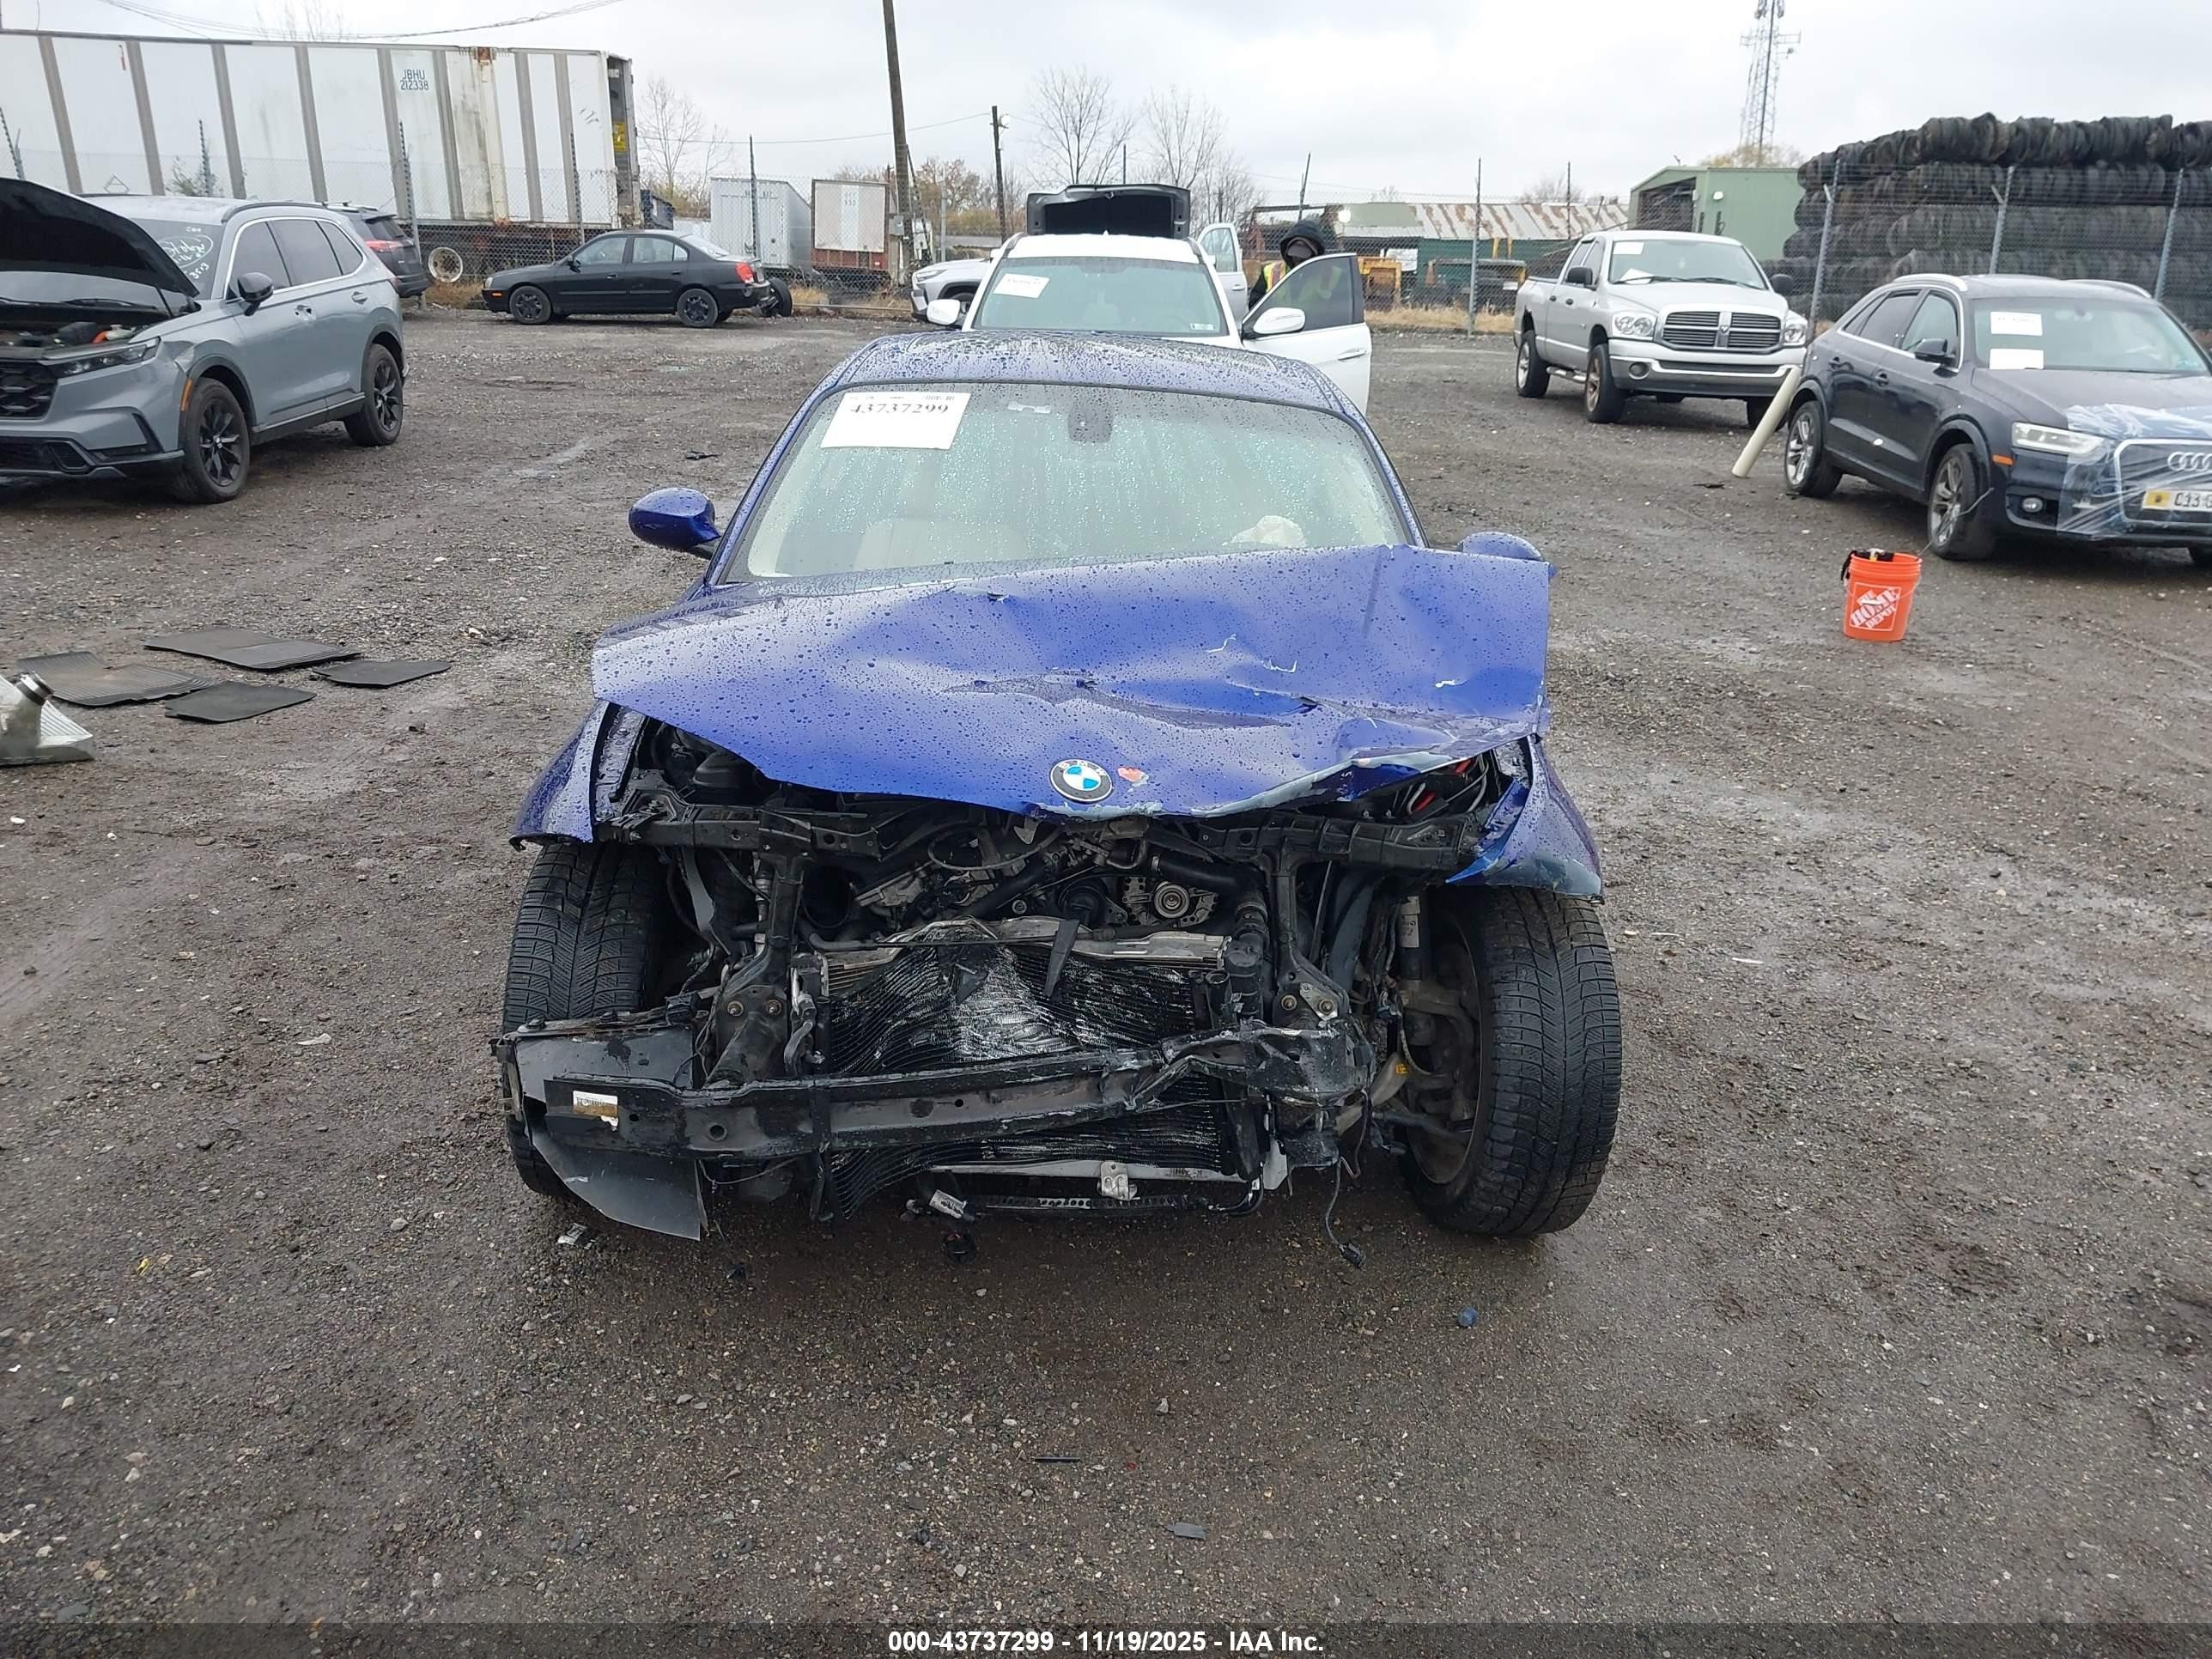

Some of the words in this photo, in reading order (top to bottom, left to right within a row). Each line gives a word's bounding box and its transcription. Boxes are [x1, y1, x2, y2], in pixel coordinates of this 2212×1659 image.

[402, 69, 426, 80] JBHU
[400, 80, 429, 90] 212338
[850, 403, 950, 414] 43737299
